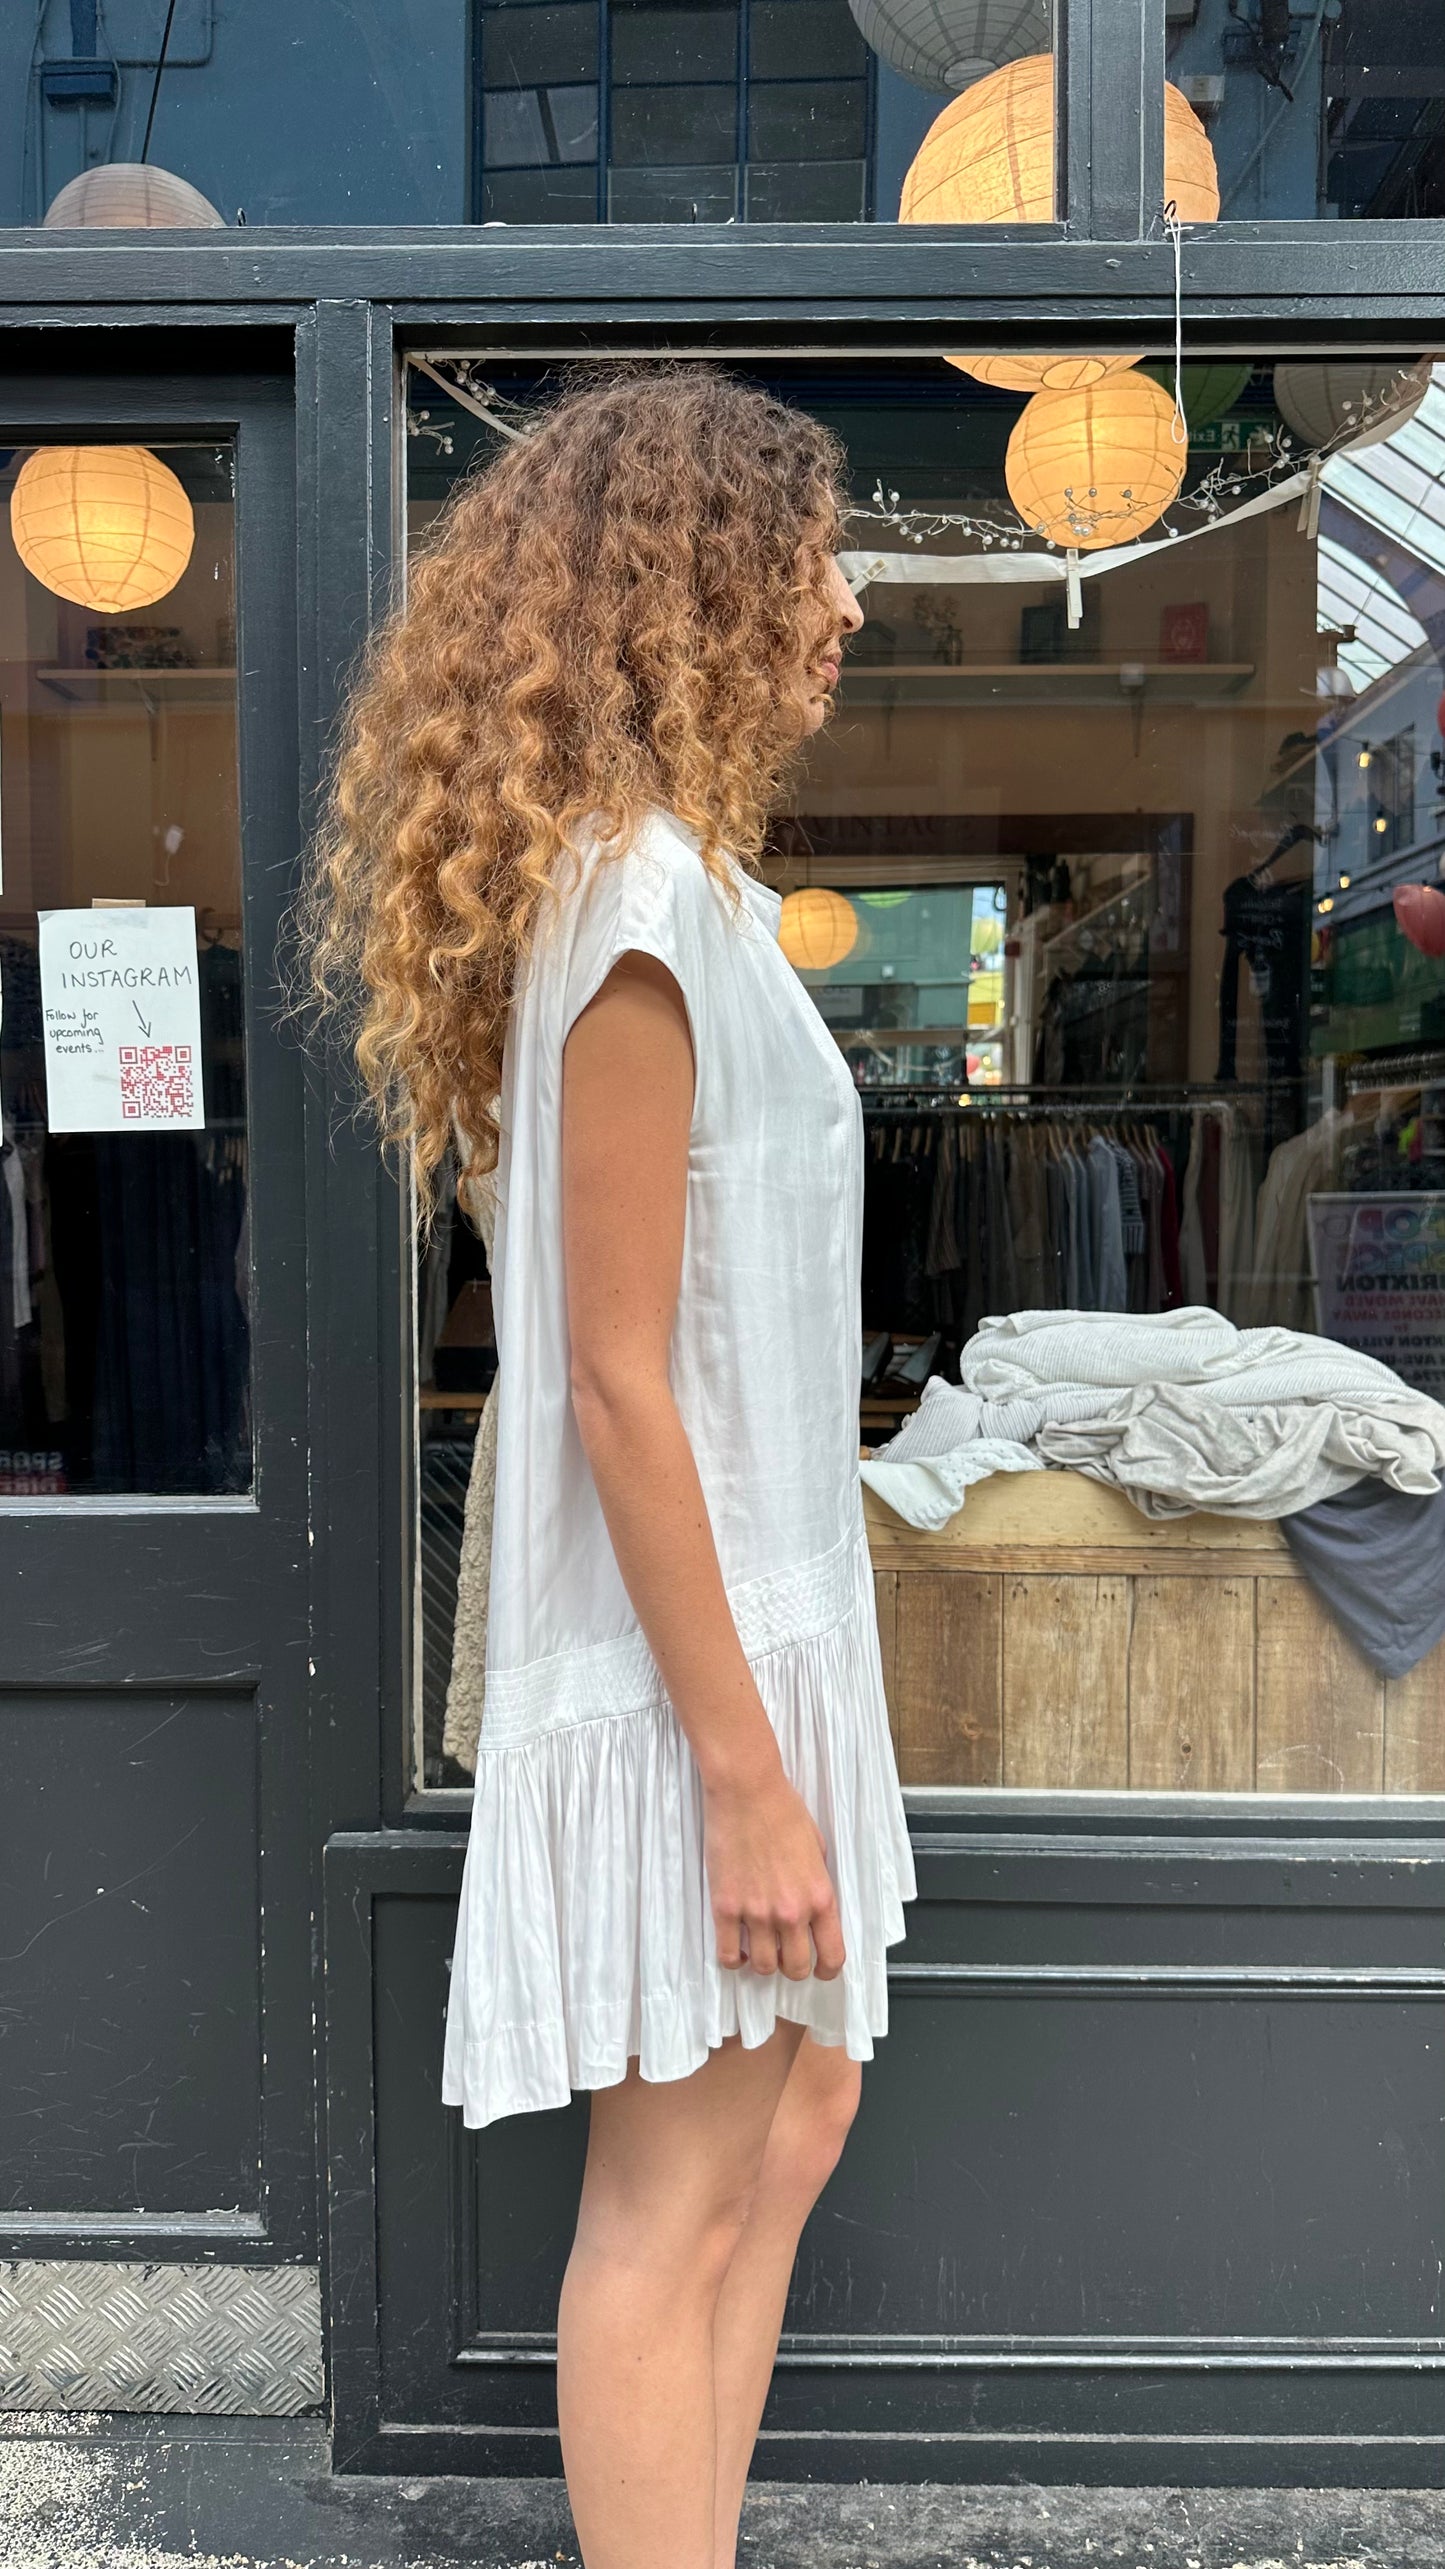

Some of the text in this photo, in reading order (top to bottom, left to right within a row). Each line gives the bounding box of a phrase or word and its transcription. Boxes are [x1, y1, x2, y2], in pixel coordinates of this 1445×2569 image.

[69, 939, 118, 959] OUR
[62, 966, 192, 989] INSTAGRAM
[46, 1008, 99, 1028] Follow for
[50, 1027, 104, 1045] upcoming
